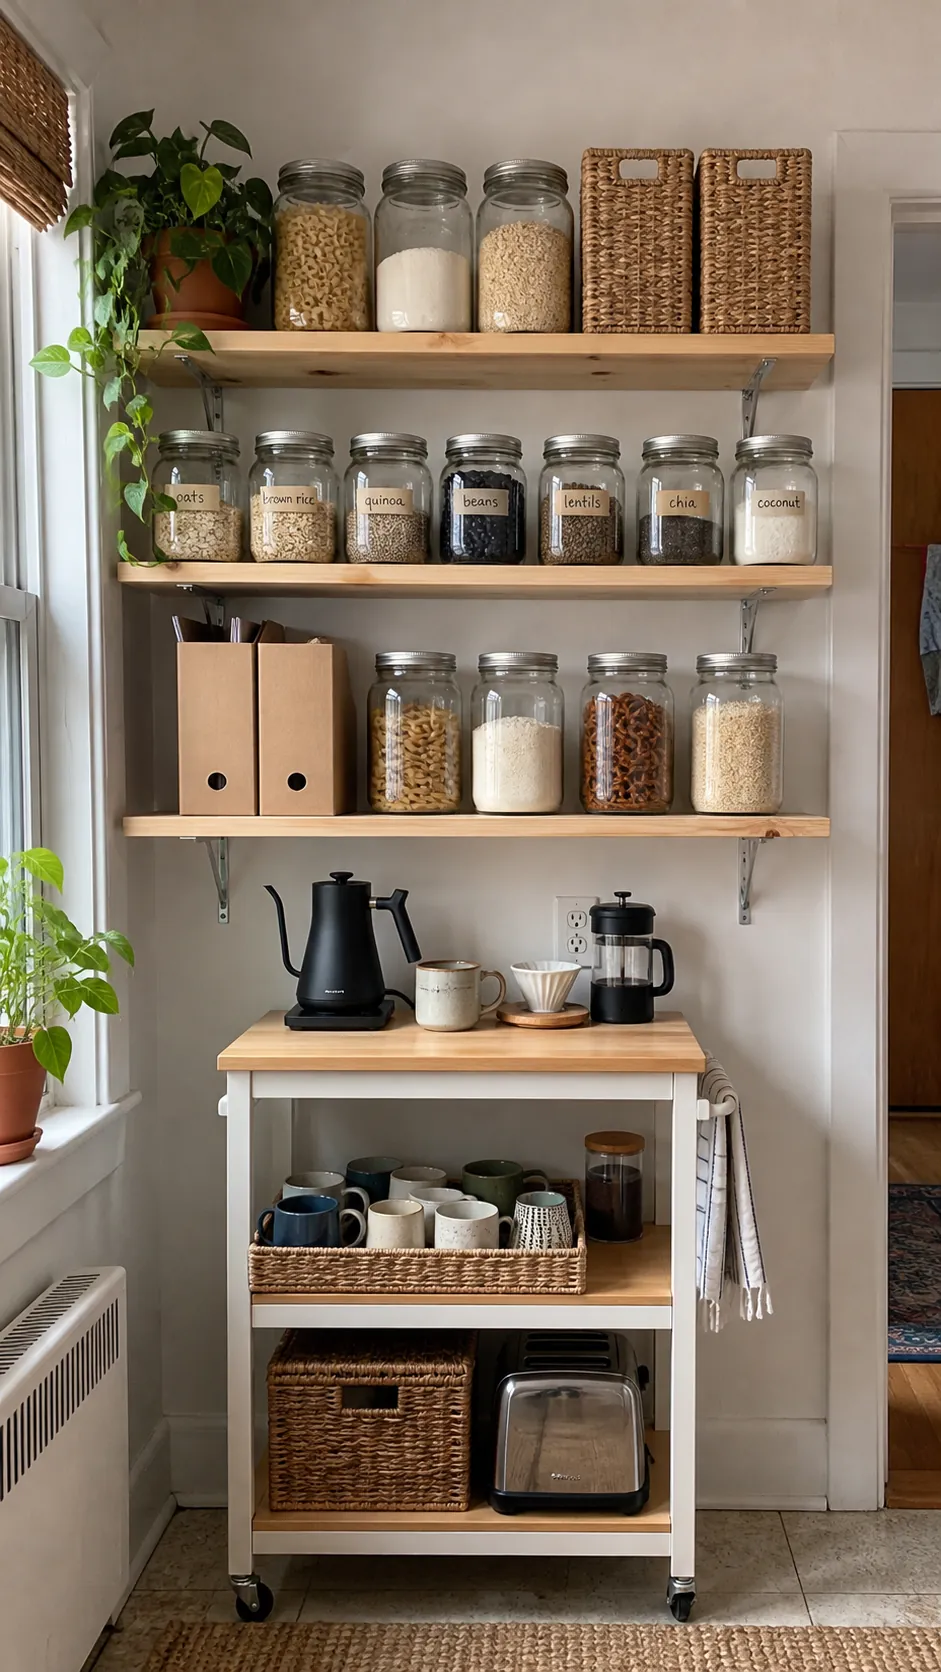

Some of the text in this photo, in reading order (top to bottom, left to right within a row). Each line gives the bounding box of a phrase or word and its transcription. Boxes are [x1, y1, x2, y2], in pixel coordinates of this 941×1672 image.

[176, 490, 204, 503] oats
[263, 492, 315, 505] brown rice
[364, 495, 405, 511] quinoa
[463, 495, 499, 508] beans
[564, 494, 601, 509] lentils
[669, 495, 697, 509] chia
[757, 496, 801, 508] coconut
